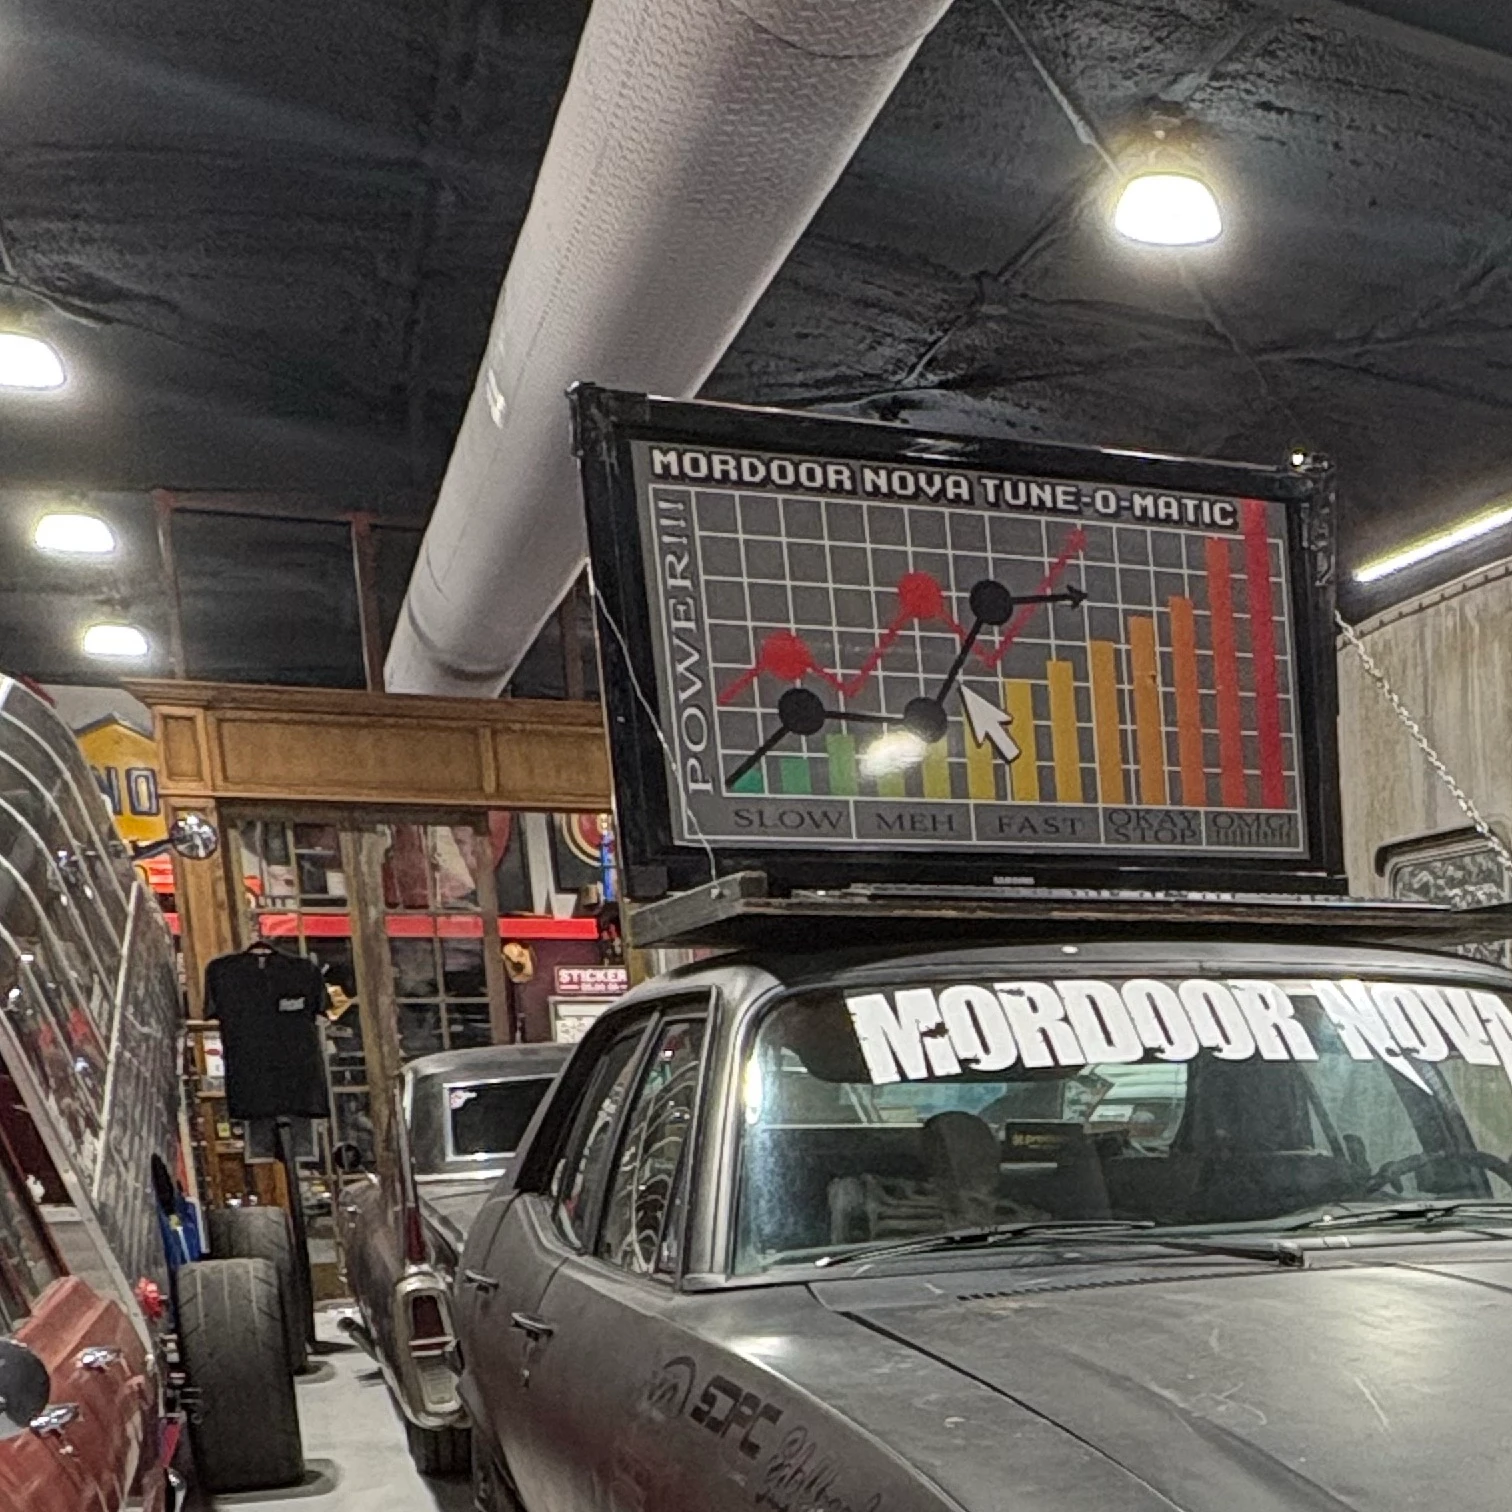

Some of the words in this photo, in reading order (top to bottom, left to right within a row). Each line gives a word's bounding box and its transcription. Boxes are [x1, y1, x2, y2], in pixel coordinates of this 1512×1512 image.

[652, 447, 852, 491] MORDOOR
[864, 468, 970, 502] NOVA
[980, 477, 1237, 526] TUNE-O-MATIC
[657, 499, 714, 795] POWER!!!
[733, 807, 847, 830] SLOW
[876, 812, 955, 833] MEH
[998, 816, 1083, 836] FAST
[1108, 809, 1198, 829] OKAY
[1114, 827, 1197, 844] STOP
[846, 978, 1318, 1085] MORDOOR
